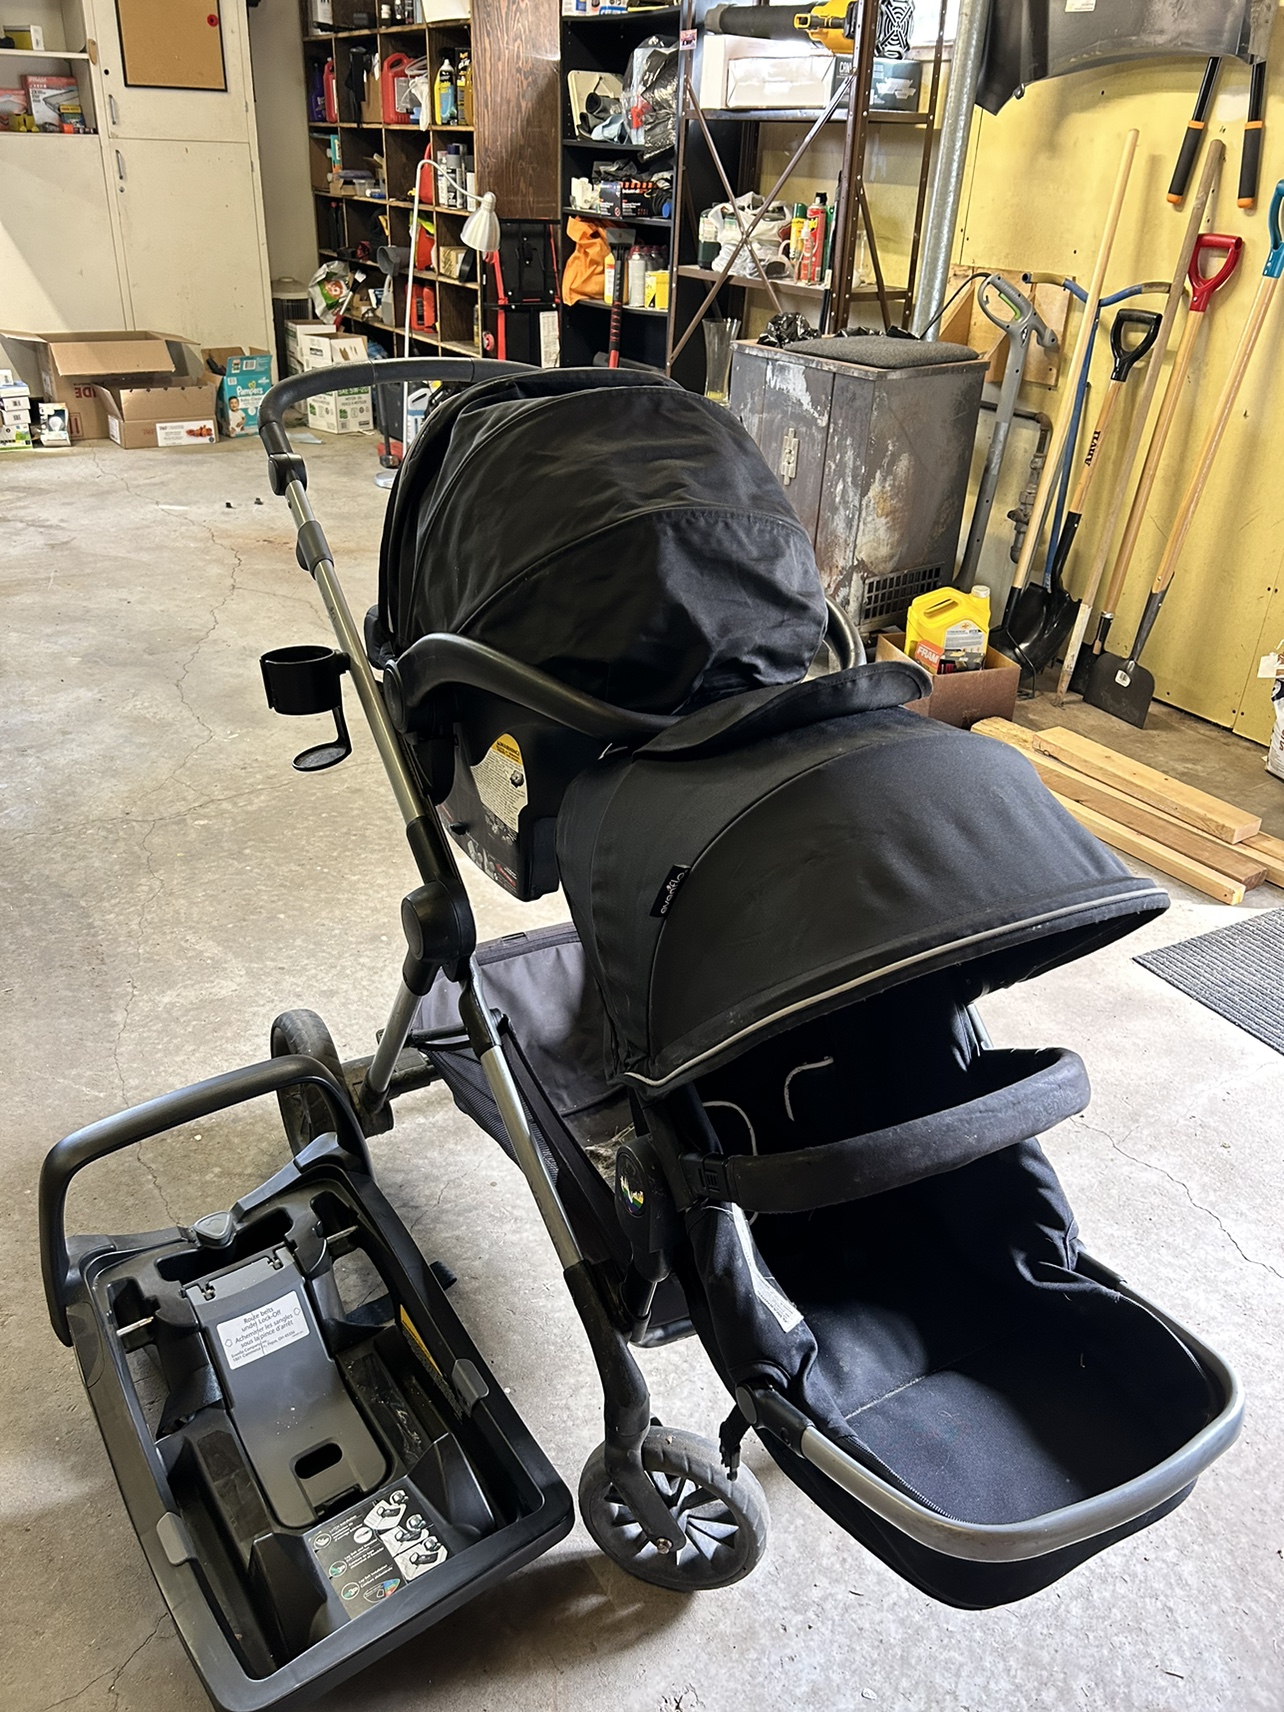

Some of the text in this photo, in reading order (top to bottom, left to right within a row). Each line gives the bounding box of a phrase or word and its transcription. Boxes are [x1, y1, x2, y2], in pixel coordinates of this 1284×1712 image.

[236, 385, 263, 397] Pampers
[1084, 430, 1101, 467] Anvil
[917, 645, 940, 664] FRAM
[241, 1310, 282, 1332] under Lock-Off
[243, 1307, 274, 1324] Route belts
[264, 1322, 273, 1330] les
[273, 1313, 294, 1327] sangles
[241, 1339, 254, 1348] sous
[259, 1329, 276, 1340] pince
